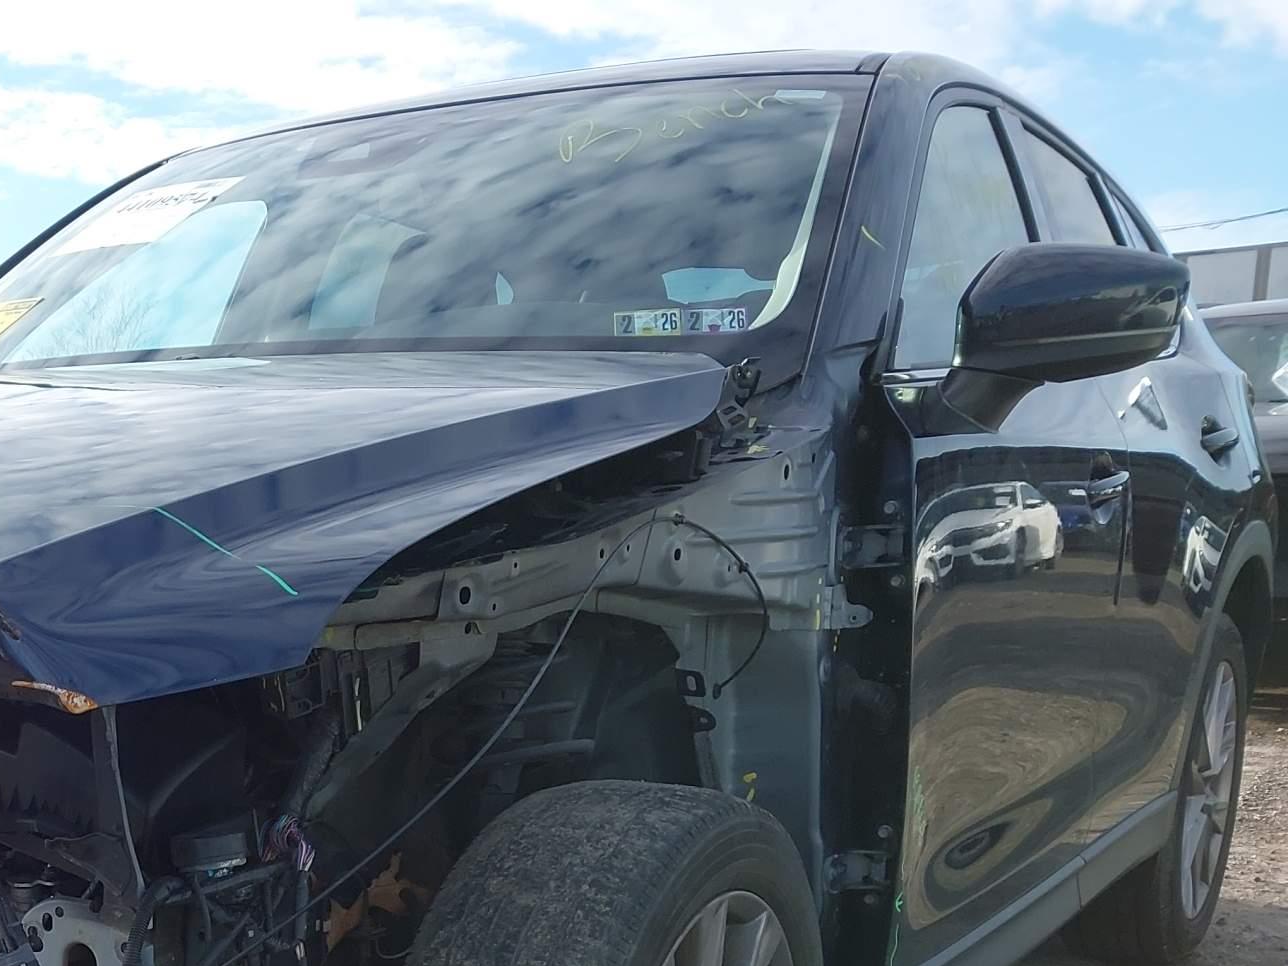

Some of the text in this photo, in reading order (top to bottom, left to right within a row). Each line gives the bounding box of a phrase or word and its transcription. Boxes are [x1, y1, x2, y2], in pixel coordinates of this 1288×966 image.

[622, 312, 678, 334] 2 26
[689, 310, 745, 331] 2 26
